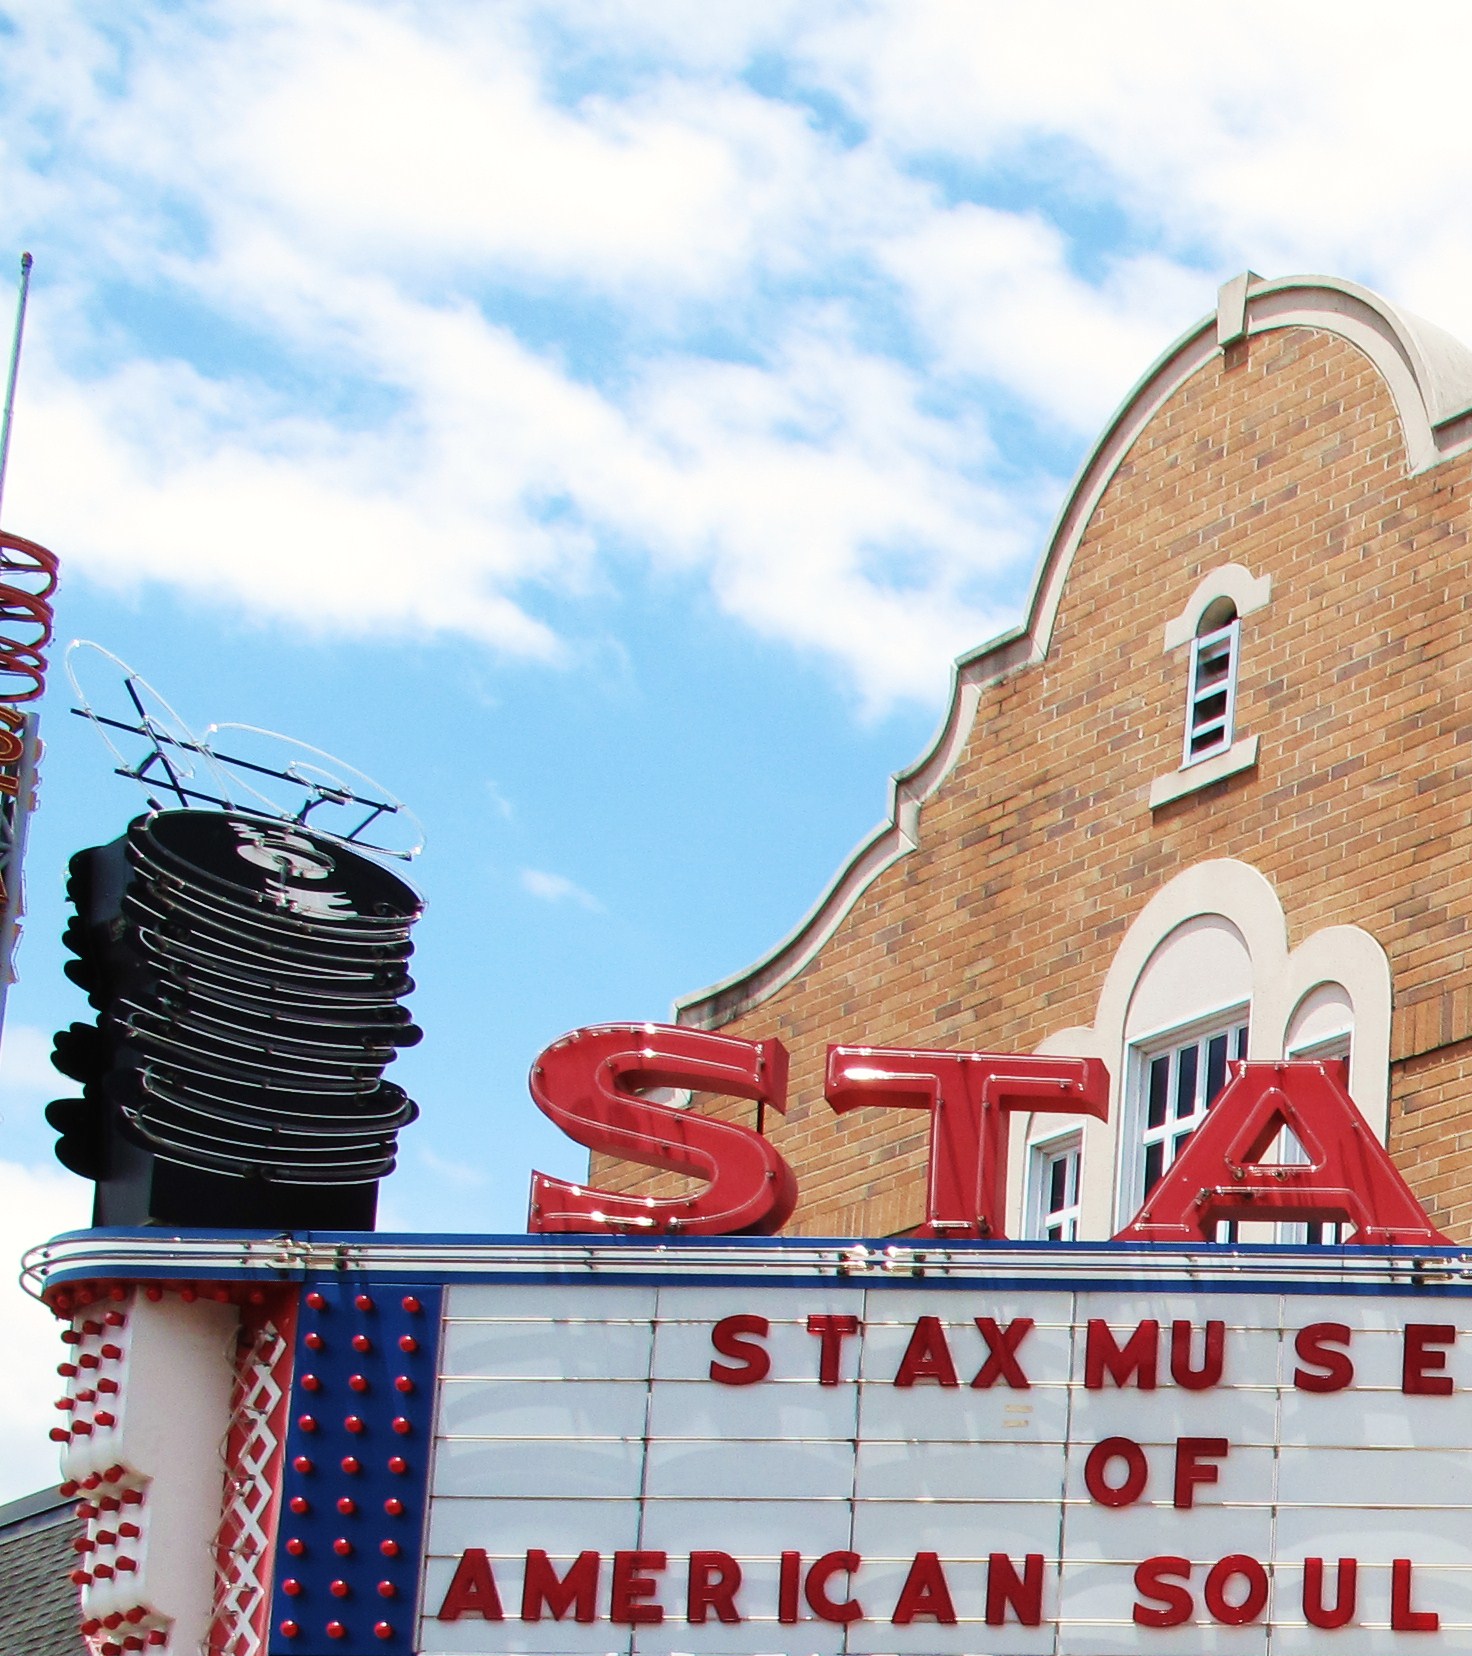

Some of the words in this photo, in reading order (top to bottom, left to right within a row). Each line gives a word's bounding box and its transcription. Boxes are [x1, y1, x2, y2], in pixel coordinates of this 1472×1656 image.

[709, 1314, 1035, 1391] STAX
[1084, 1436, 1229, 1510] OF
[438, 1548, 1045, 1627] AMERICAN
[1132, 1554, 1440, 1633] SOUL
